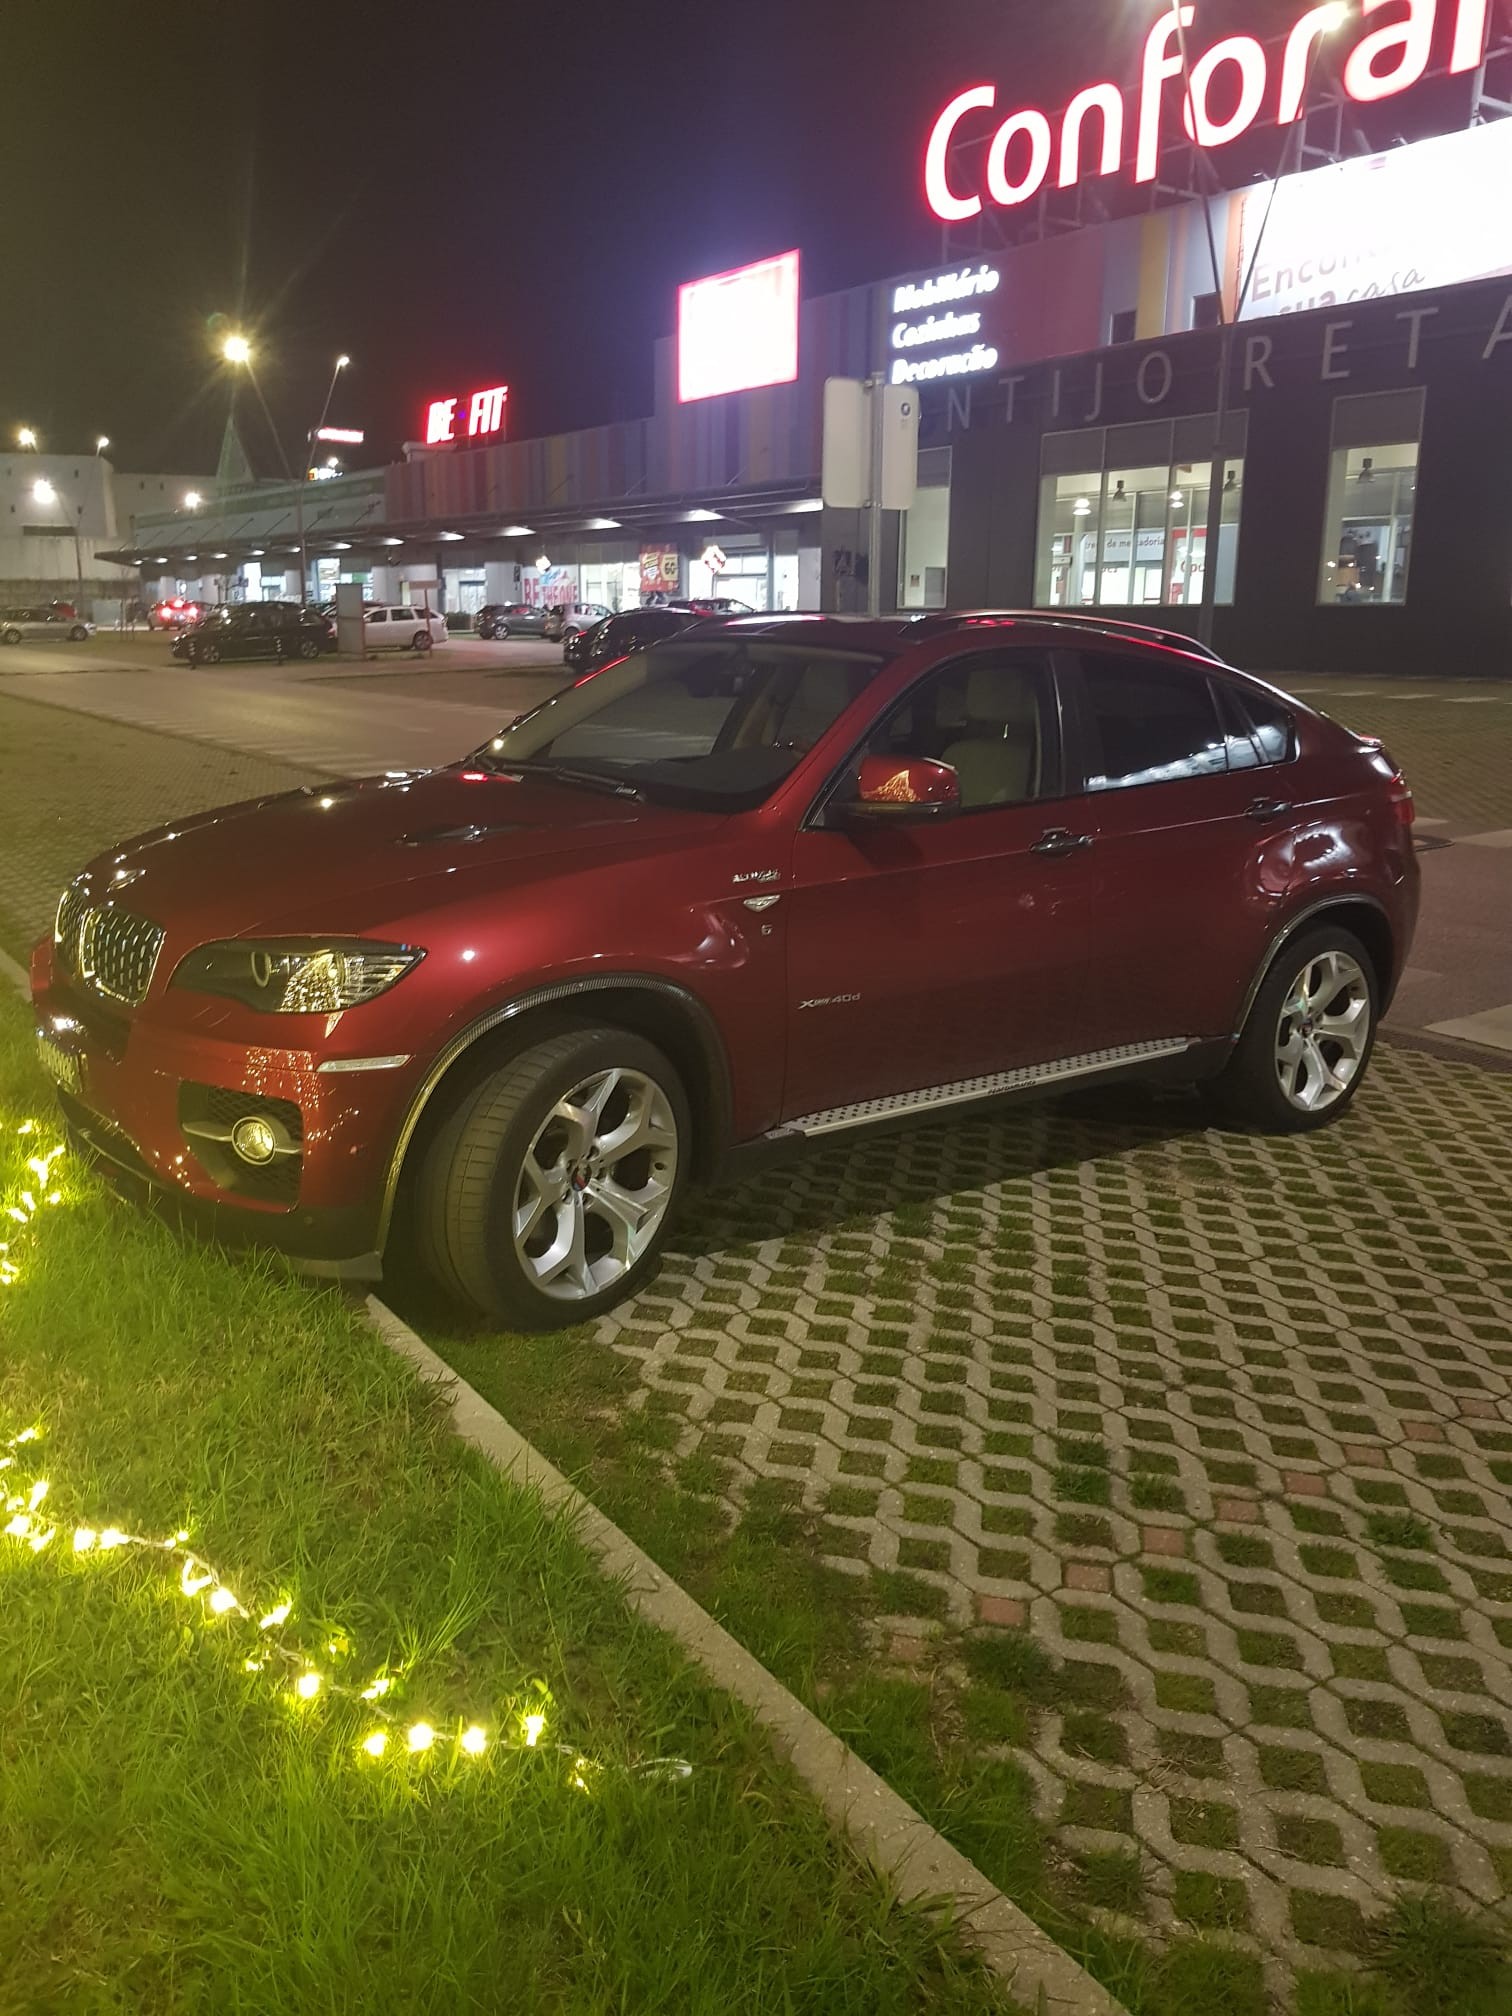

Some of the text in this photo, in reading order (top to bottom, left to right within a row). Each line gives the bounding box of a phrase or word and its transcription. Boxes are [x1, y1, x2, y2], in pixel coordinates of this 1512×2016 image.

[924, 0, 1487, 222] Confora
[893, 264, 1000, 314] Mobiliário
[892, 311, 982, 349] Cozinhas
[891, 343, 999, 385] Decoração
[427, 386, 508, 444] BE FIT
